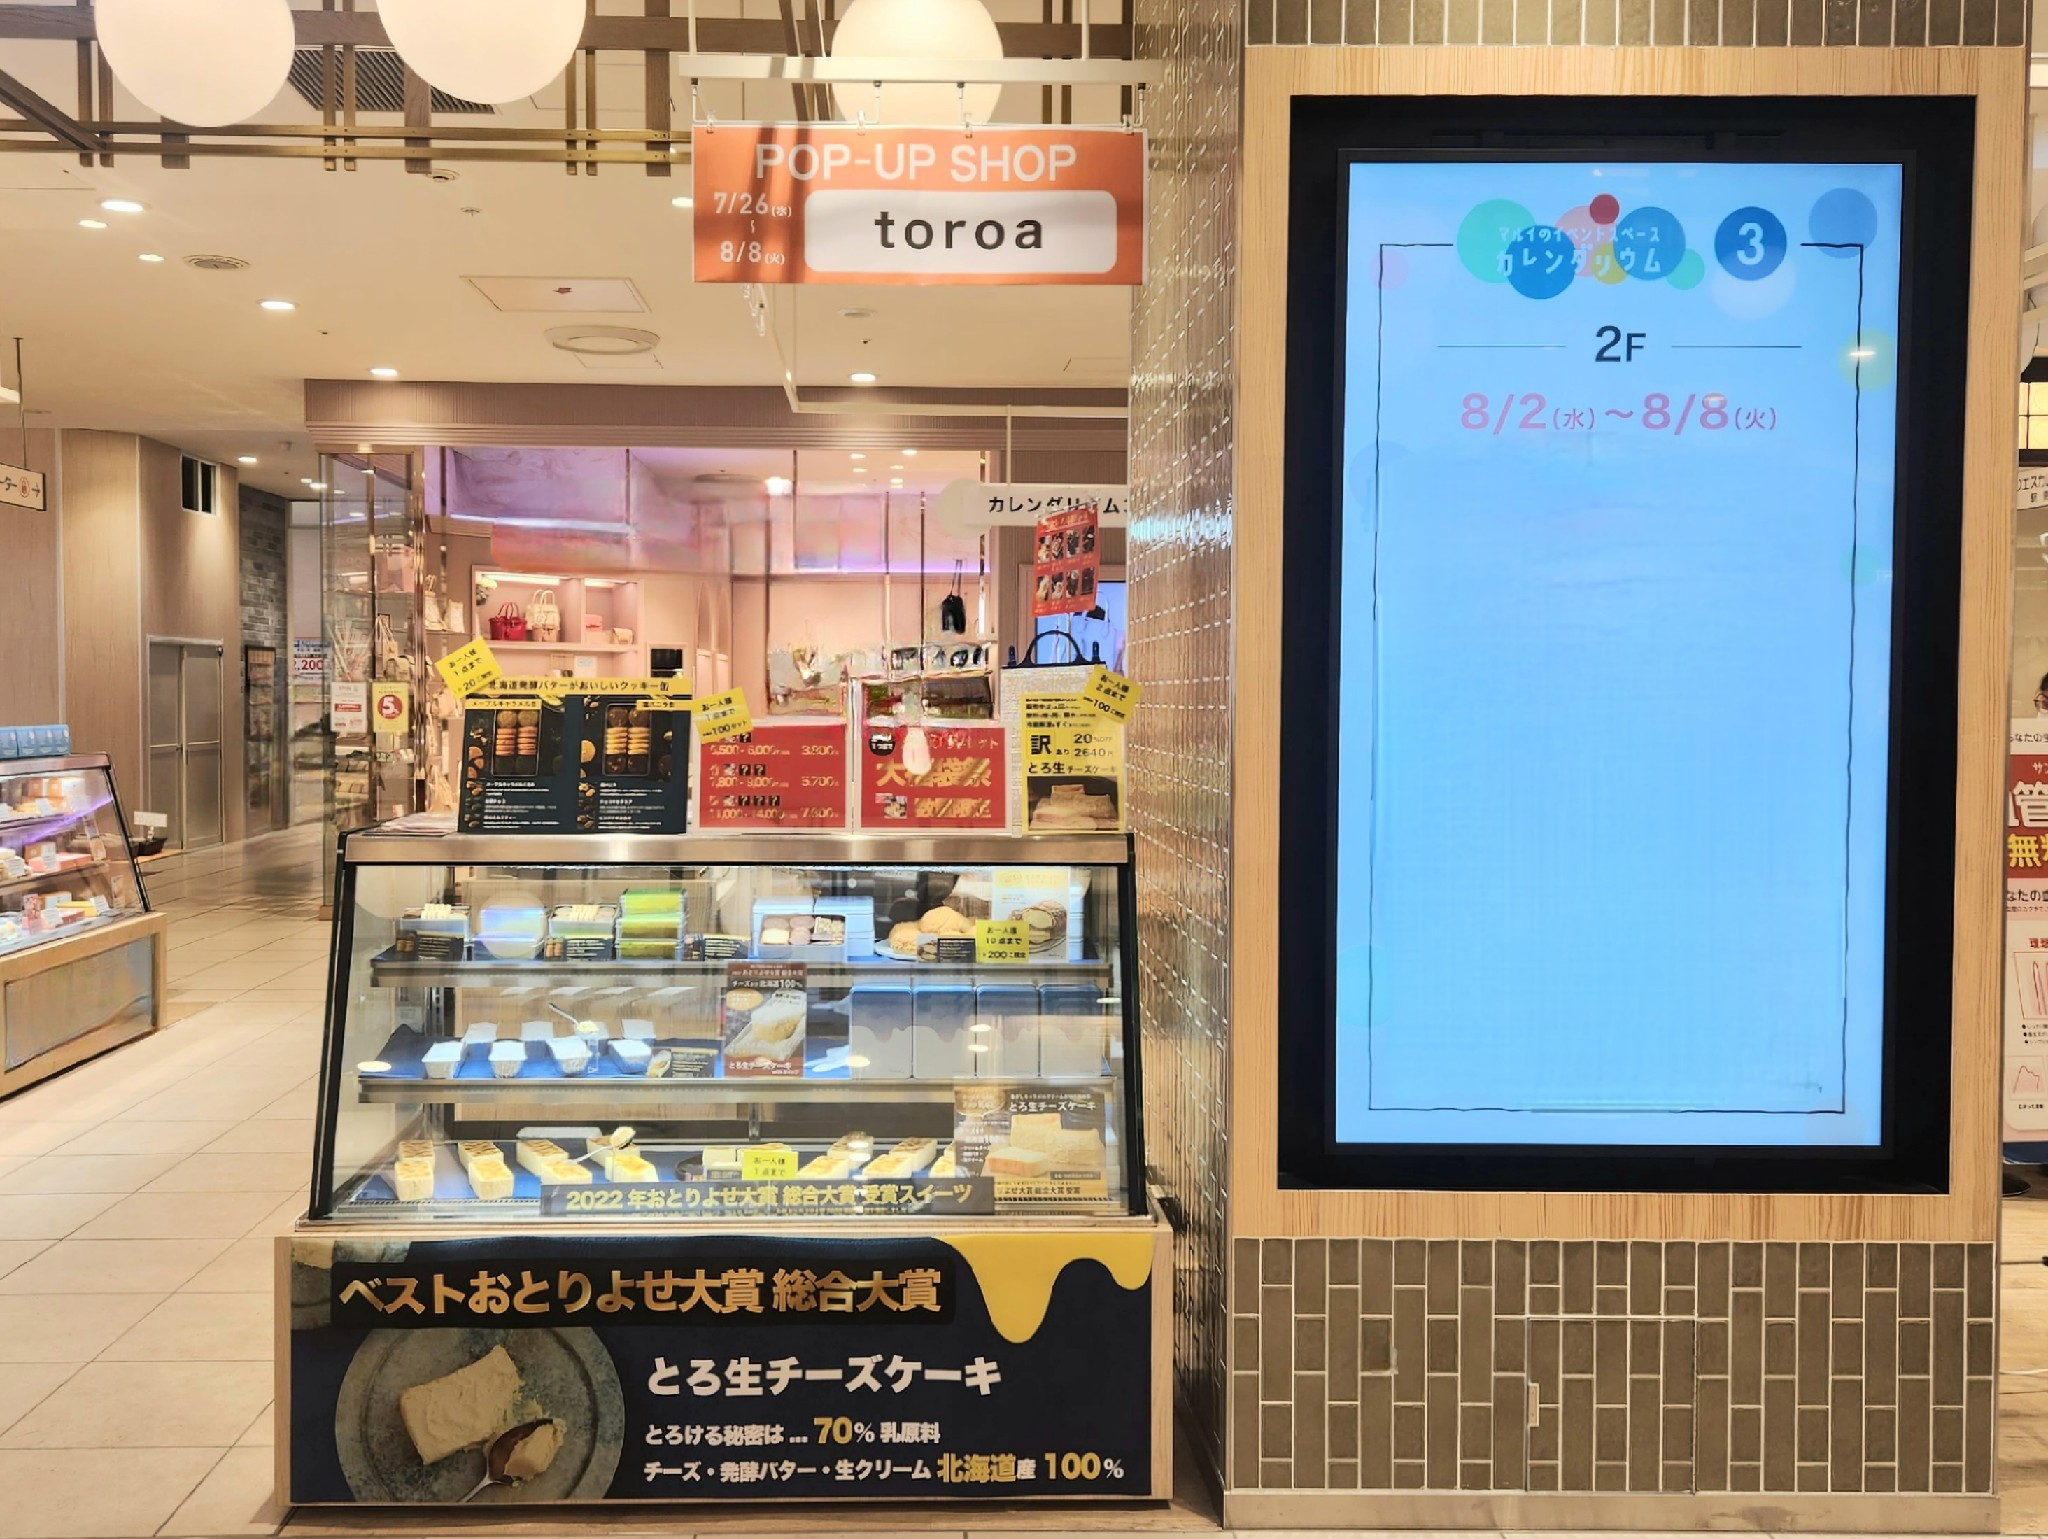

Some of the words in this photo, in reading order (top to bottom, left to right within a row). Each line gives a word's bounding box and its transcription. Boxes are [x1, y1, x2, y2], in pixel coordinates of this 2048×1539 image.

[756, 143, 936, 180] POP-UP
[950, 144, 1077, 182] SHOP
[874, 210, 1044, 250] toroa
[1499, 226, 1661, 242] マルイのイベントスペース
[1736, 222, 1766, 266] 3
[719, 240, 786, 265] 8/8(火)
[1496, 243, 1662, 277] カレンダリウム
[1594, 325, 1648, 363] 2F
[487, 680, 670, 692] 北海道発酵バターがおいしいクッキー缶
[702, 719, 747, 737] 100セット
[1028, 762, 1116, 774] とろ生チーズケーキ
[1009, 1100, 1097, 1112] とろ生チーズケーキ
[753, 1156, 786, 1165] お一人様
[566, 1190, 623, 1211] 2022
[627, 1185, 778, 1209] 年おとりよせ大賞
[782, 1184, 854, 1207] 総合大賞
[339, 1268, 765, 1315] ベストおとりよせ大賞
[772, 1268, 942, 1313] 総合大賞
[646, 1354, 1002, 1397] とろ生チーズケーキ
[644, 1424, 784, 1447] とろける秘密は
[813, 1416, 875, 1445] 70%
[879, 1421, 941, 1444] 乳原料
[643, 1459, 932, 1483] チーズ・発酵バター・生クリーム
[936, 1452, 1037, 1484] 北海道産
[1043, 1451, 1125, 1481] 100%
